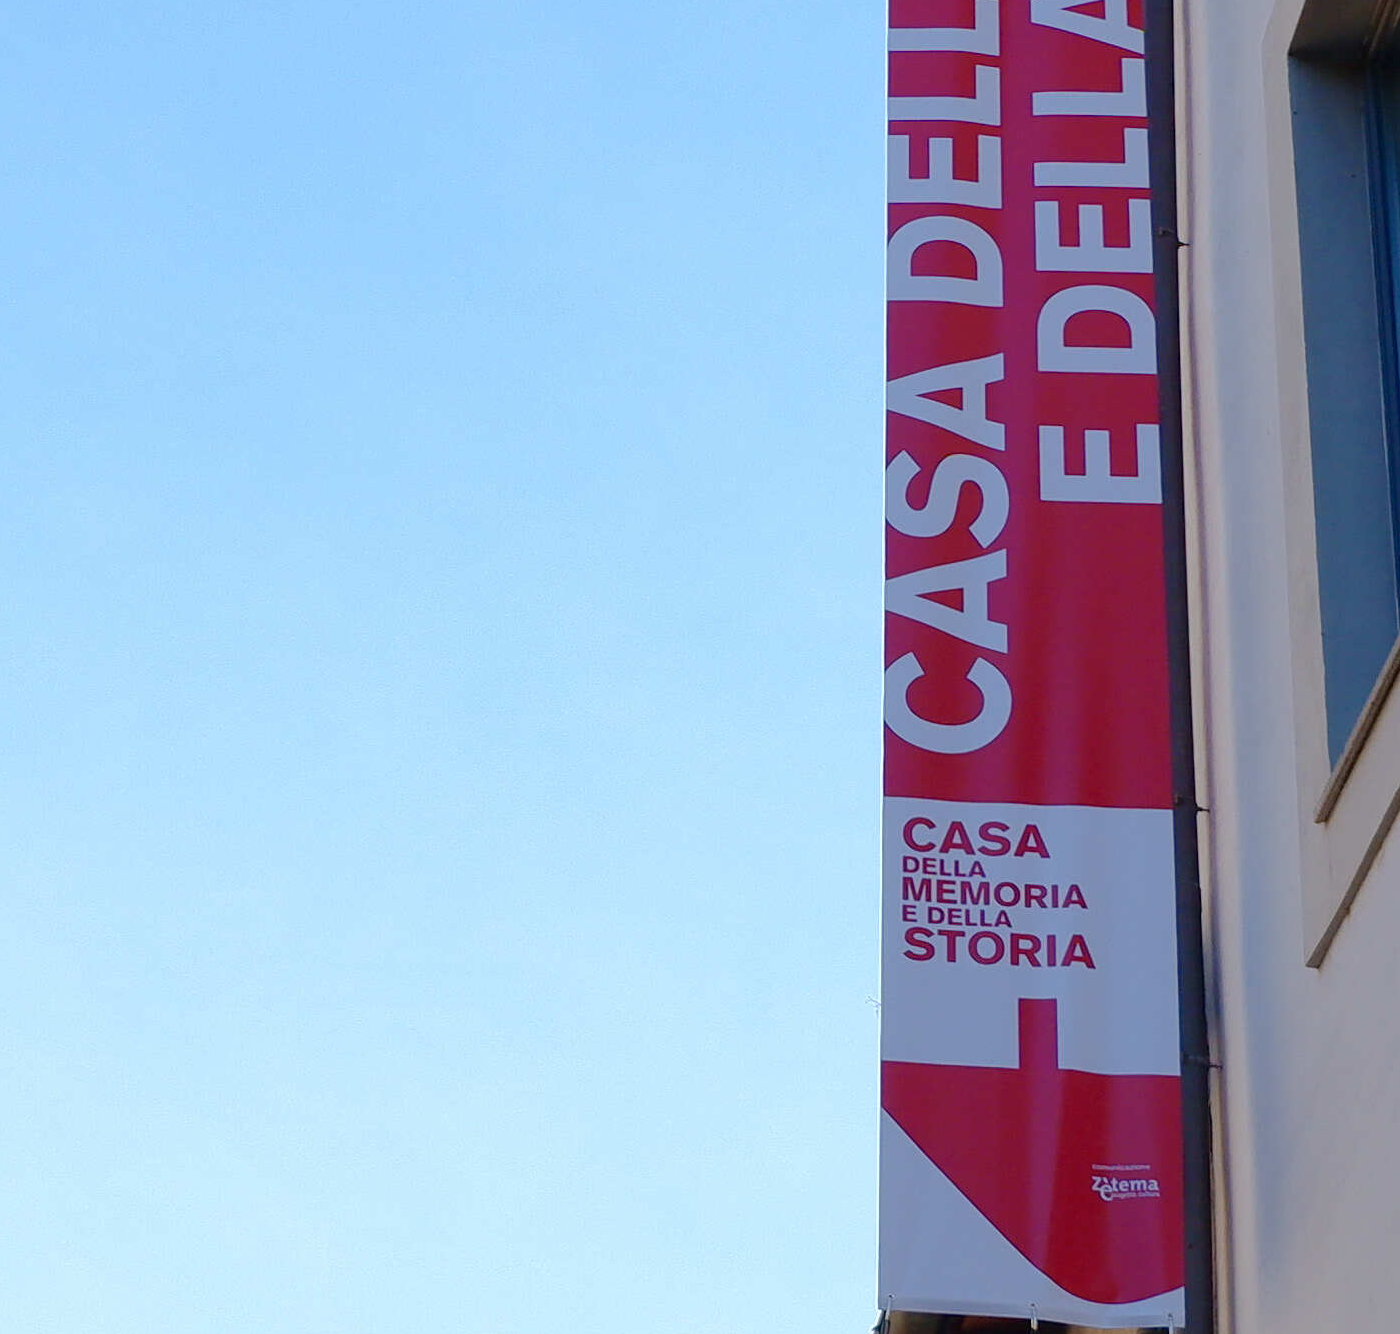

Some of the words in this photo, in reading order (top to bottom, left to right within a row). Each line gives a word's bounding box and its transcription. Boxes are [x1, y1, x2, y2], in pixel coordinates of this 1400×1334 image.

[1038, 423, 1164, 505] E
[884, 352, 1013, 755] CASA
[903, 817, 1051, 859] CASA
[902, 855, 987, 878] DELLA
[902, 877, 1089, 909] MEMORIA
[902, 904, 918, 922] E
[927, 906, 1013, 928] DELLA
[903, 926, 1097, 970] STORIA
